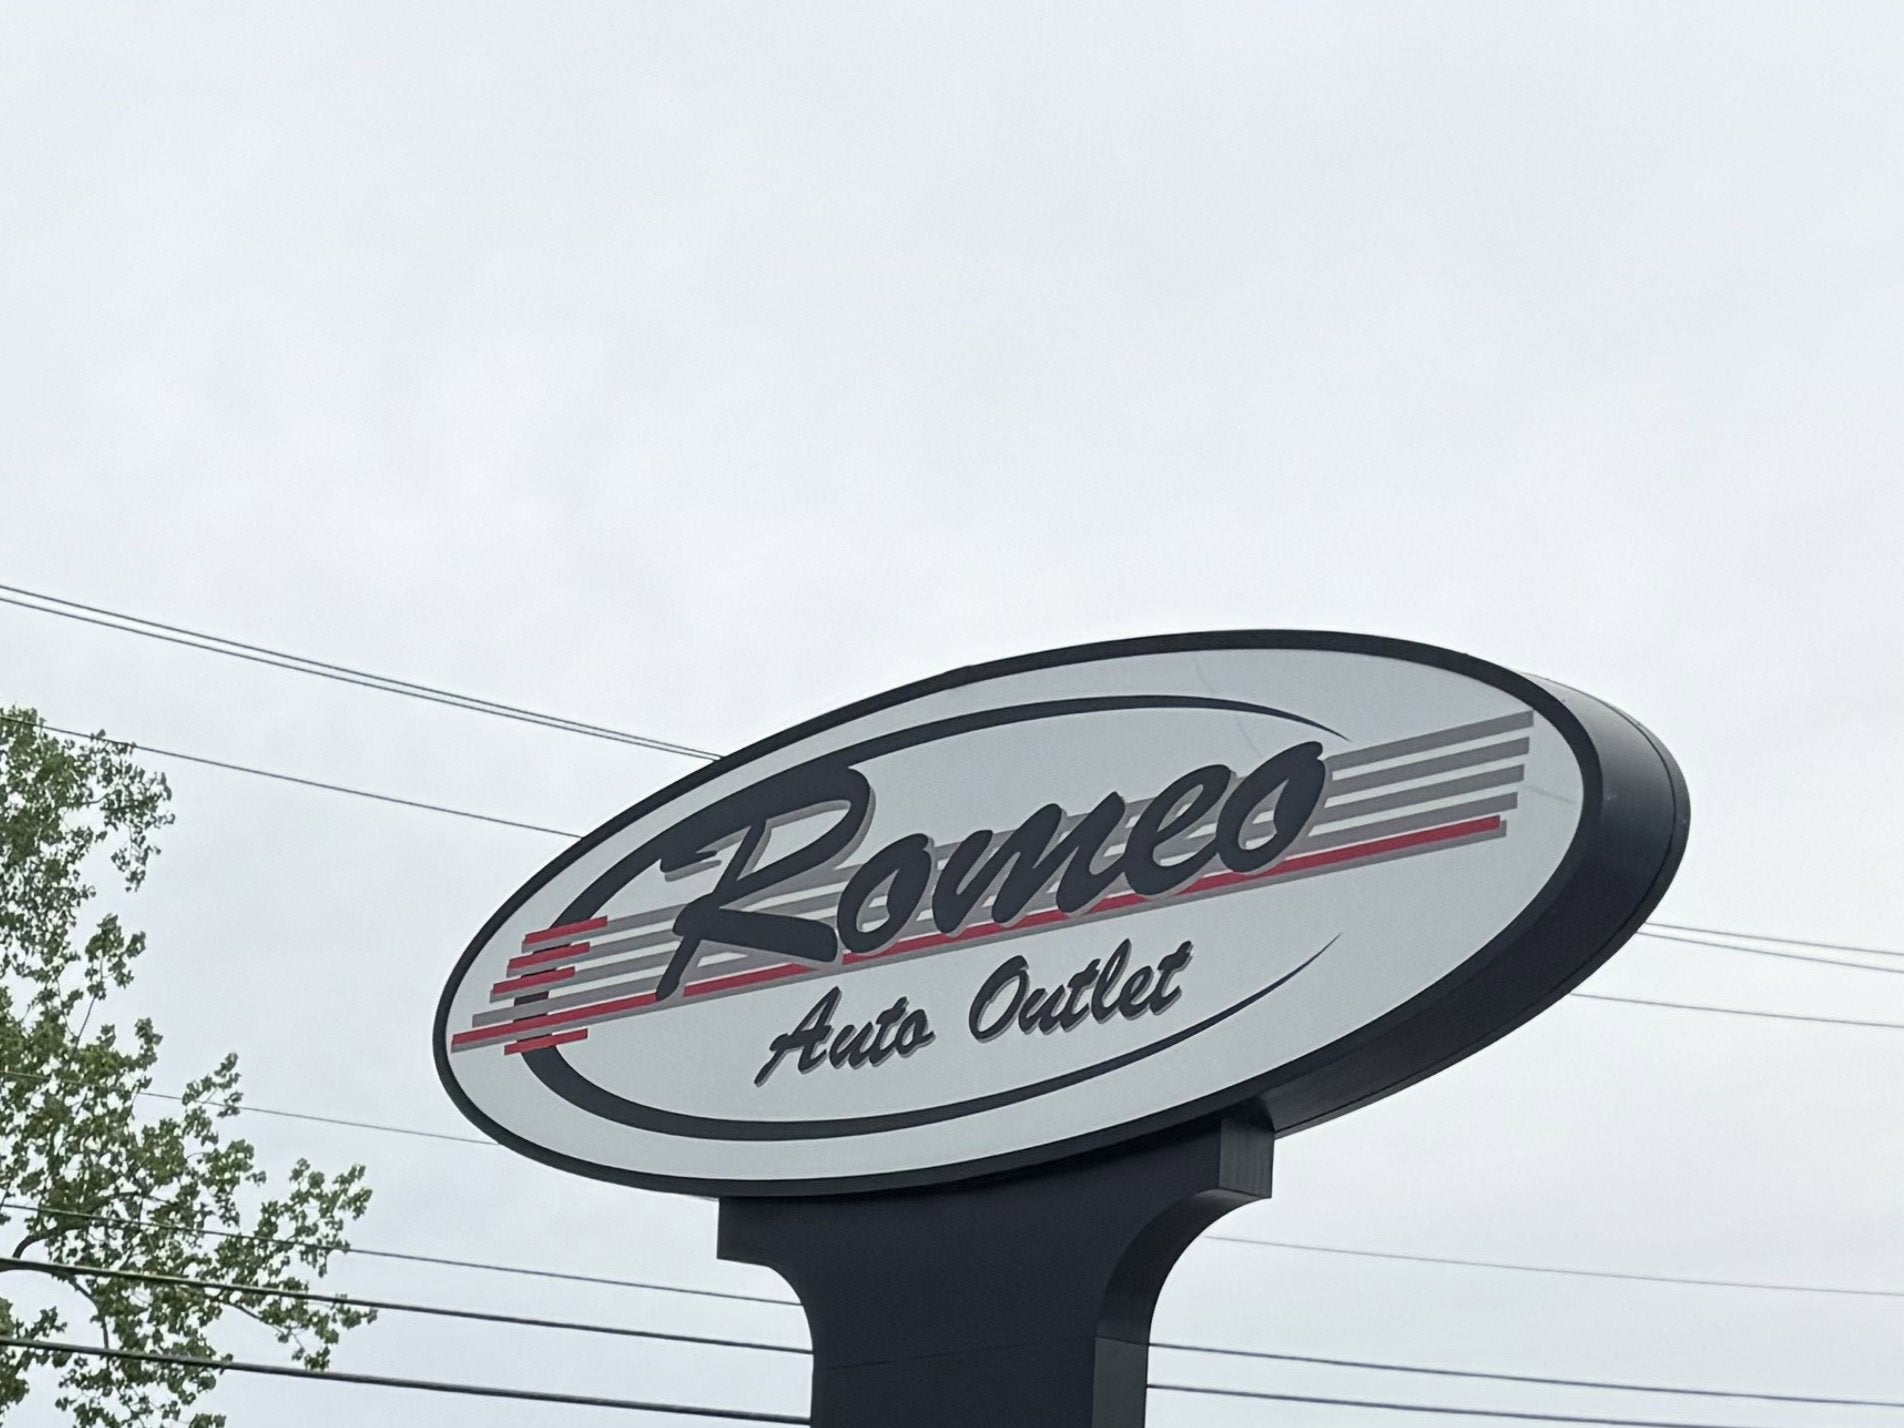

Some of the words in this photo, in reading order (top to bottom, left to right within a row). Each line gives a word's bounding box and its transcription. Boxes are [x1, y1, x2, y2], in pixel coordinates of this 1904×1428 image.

[656, 740, 1328, 1001] Romeo
[753, 985, 936, 1087] Auto
[967, 937, 1194, 1044] Outlet
